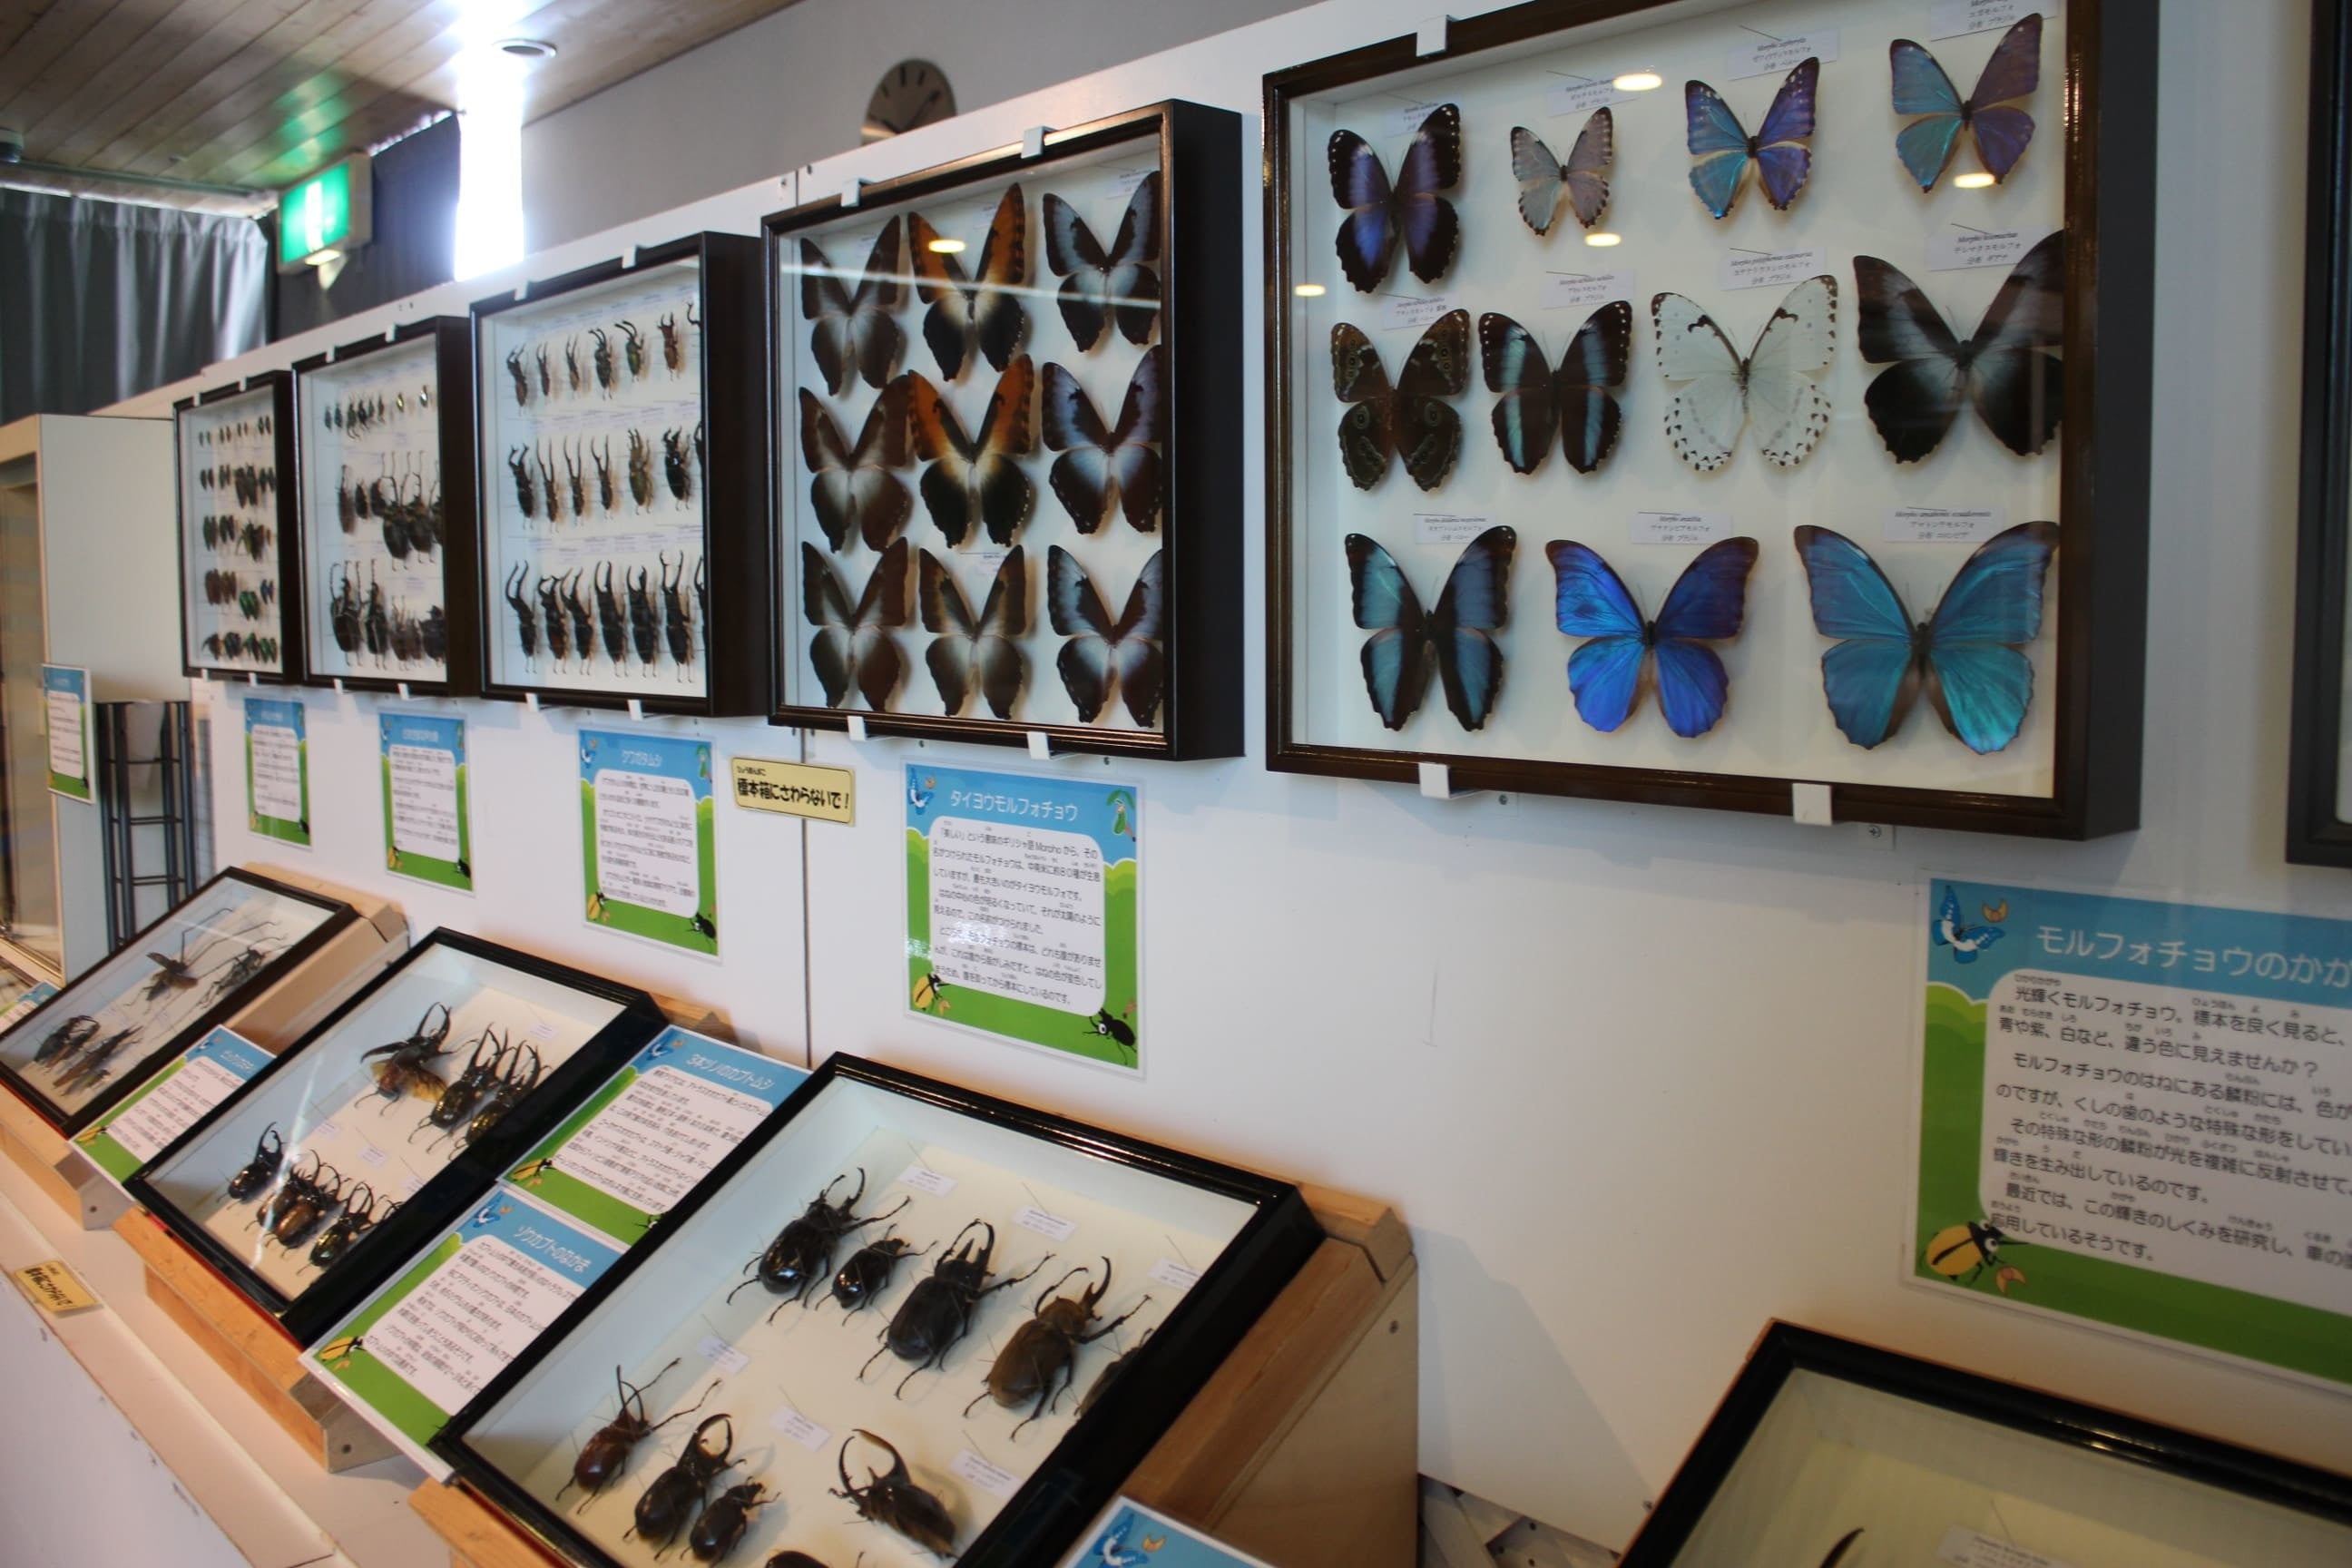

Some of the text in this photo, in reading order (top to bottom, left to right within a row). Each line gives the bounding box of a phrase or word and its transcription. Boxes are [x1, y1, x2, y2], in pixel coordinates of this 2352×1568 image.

[737, 778, 849, 809] 標本箱にさわらないで！
[950, 789, 1079, 822] タイヨウモルフォチョウ
[2015, 986, 2345, 1046] 光輝くモルフォチョウ。標本を良く見ると、
[1999, 1017, 2318, 1078] 青や紫、白など、違う色に見えませんか？
[1994, 1148, 2208, 1204] 輝きを生み出しているのです。
[1990, 1212, 2154, 1261] 応用しているそうです。
